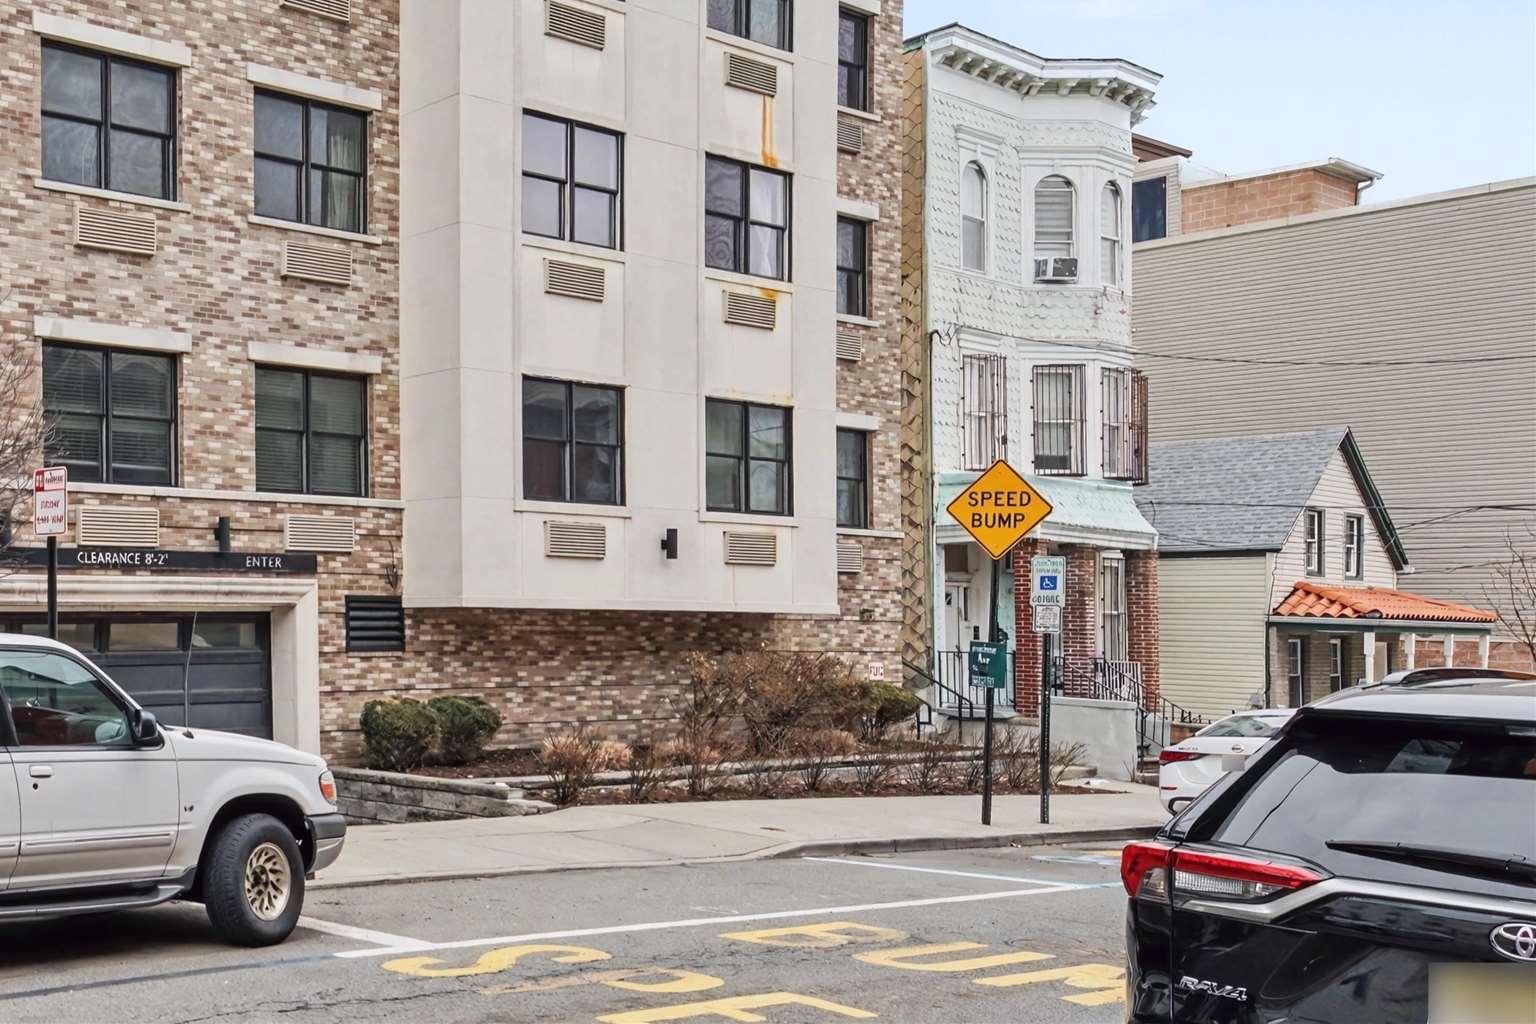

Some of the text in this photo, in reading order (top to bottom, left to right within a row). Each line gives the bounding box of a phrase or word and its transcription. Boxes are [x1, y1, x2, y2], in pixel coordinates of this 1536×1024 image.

[968, 491, 1032, 507] SPEED
[971, 512, 1026, 529] BUMP
[77, 551, 141, 565] CLEARANCE
[246, 555, 282, 569] ENTER
[718, 921, 1126, 1008] BUM
[1180, 975, 1248, 1002] RAV4
